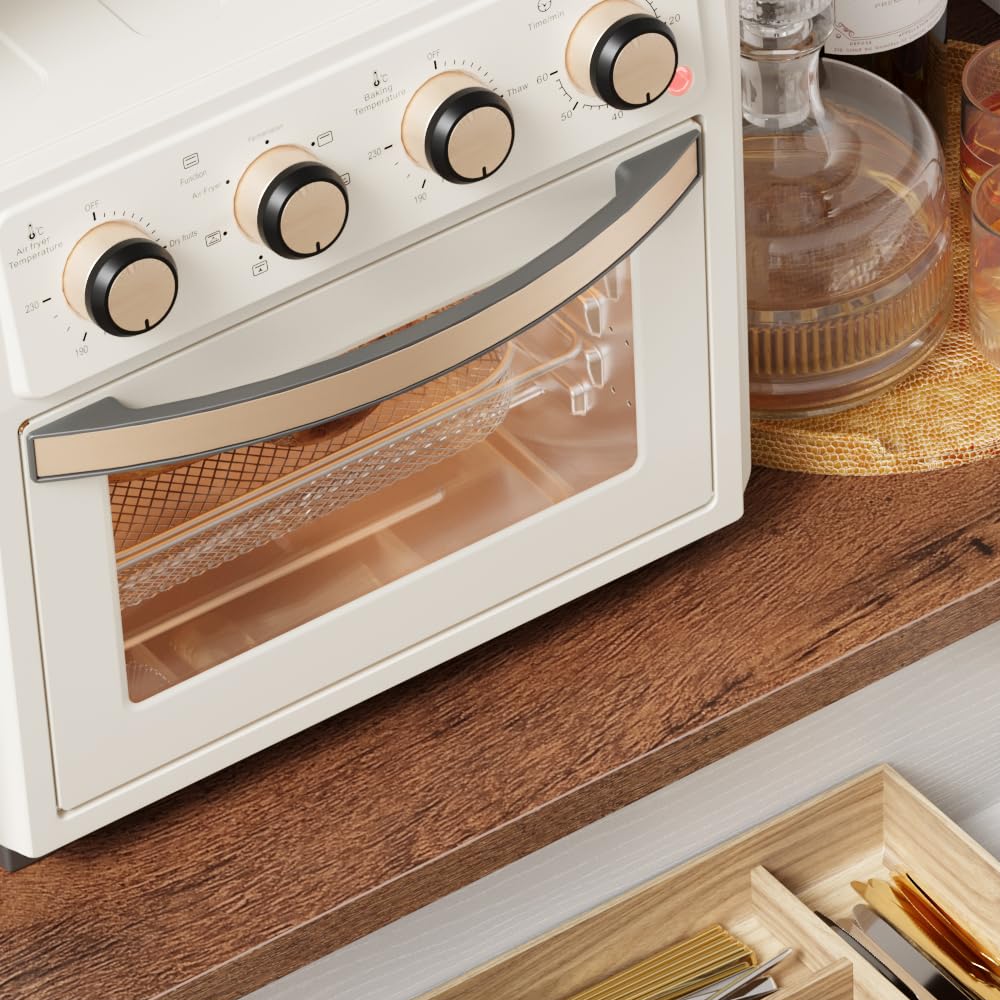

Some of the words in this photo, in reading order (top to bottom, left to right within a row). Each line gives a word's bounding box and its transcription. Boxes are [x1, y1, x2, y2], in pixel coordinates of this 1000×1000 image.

[528, 11, 566, 31] Time/min
[669, 14, 681, 25] 20
[427, 49, 440, 60] OFF
[536, 73, 549, 84] 60
[363, 85, 393, 102] Baking
[506, 82, 529, 97] Thaw
[354, 88, 407, 116] Temperature
[561, 110, 573, 122] 50
[612, 111, 624, 121] 40
[368, 147, 382, 160] 230
[414, 192, 427, 204] 190
[84, 200, 100, 213] OFF
[16, 243, 30, 257] Air
[29, 236, 50, 252] fryer
[169, 237, 181, 249] Dry
[8, 241, 63, 270] Temperature
[24, 302, 40, 315] 230
[75, 344, 89, 357] 190
